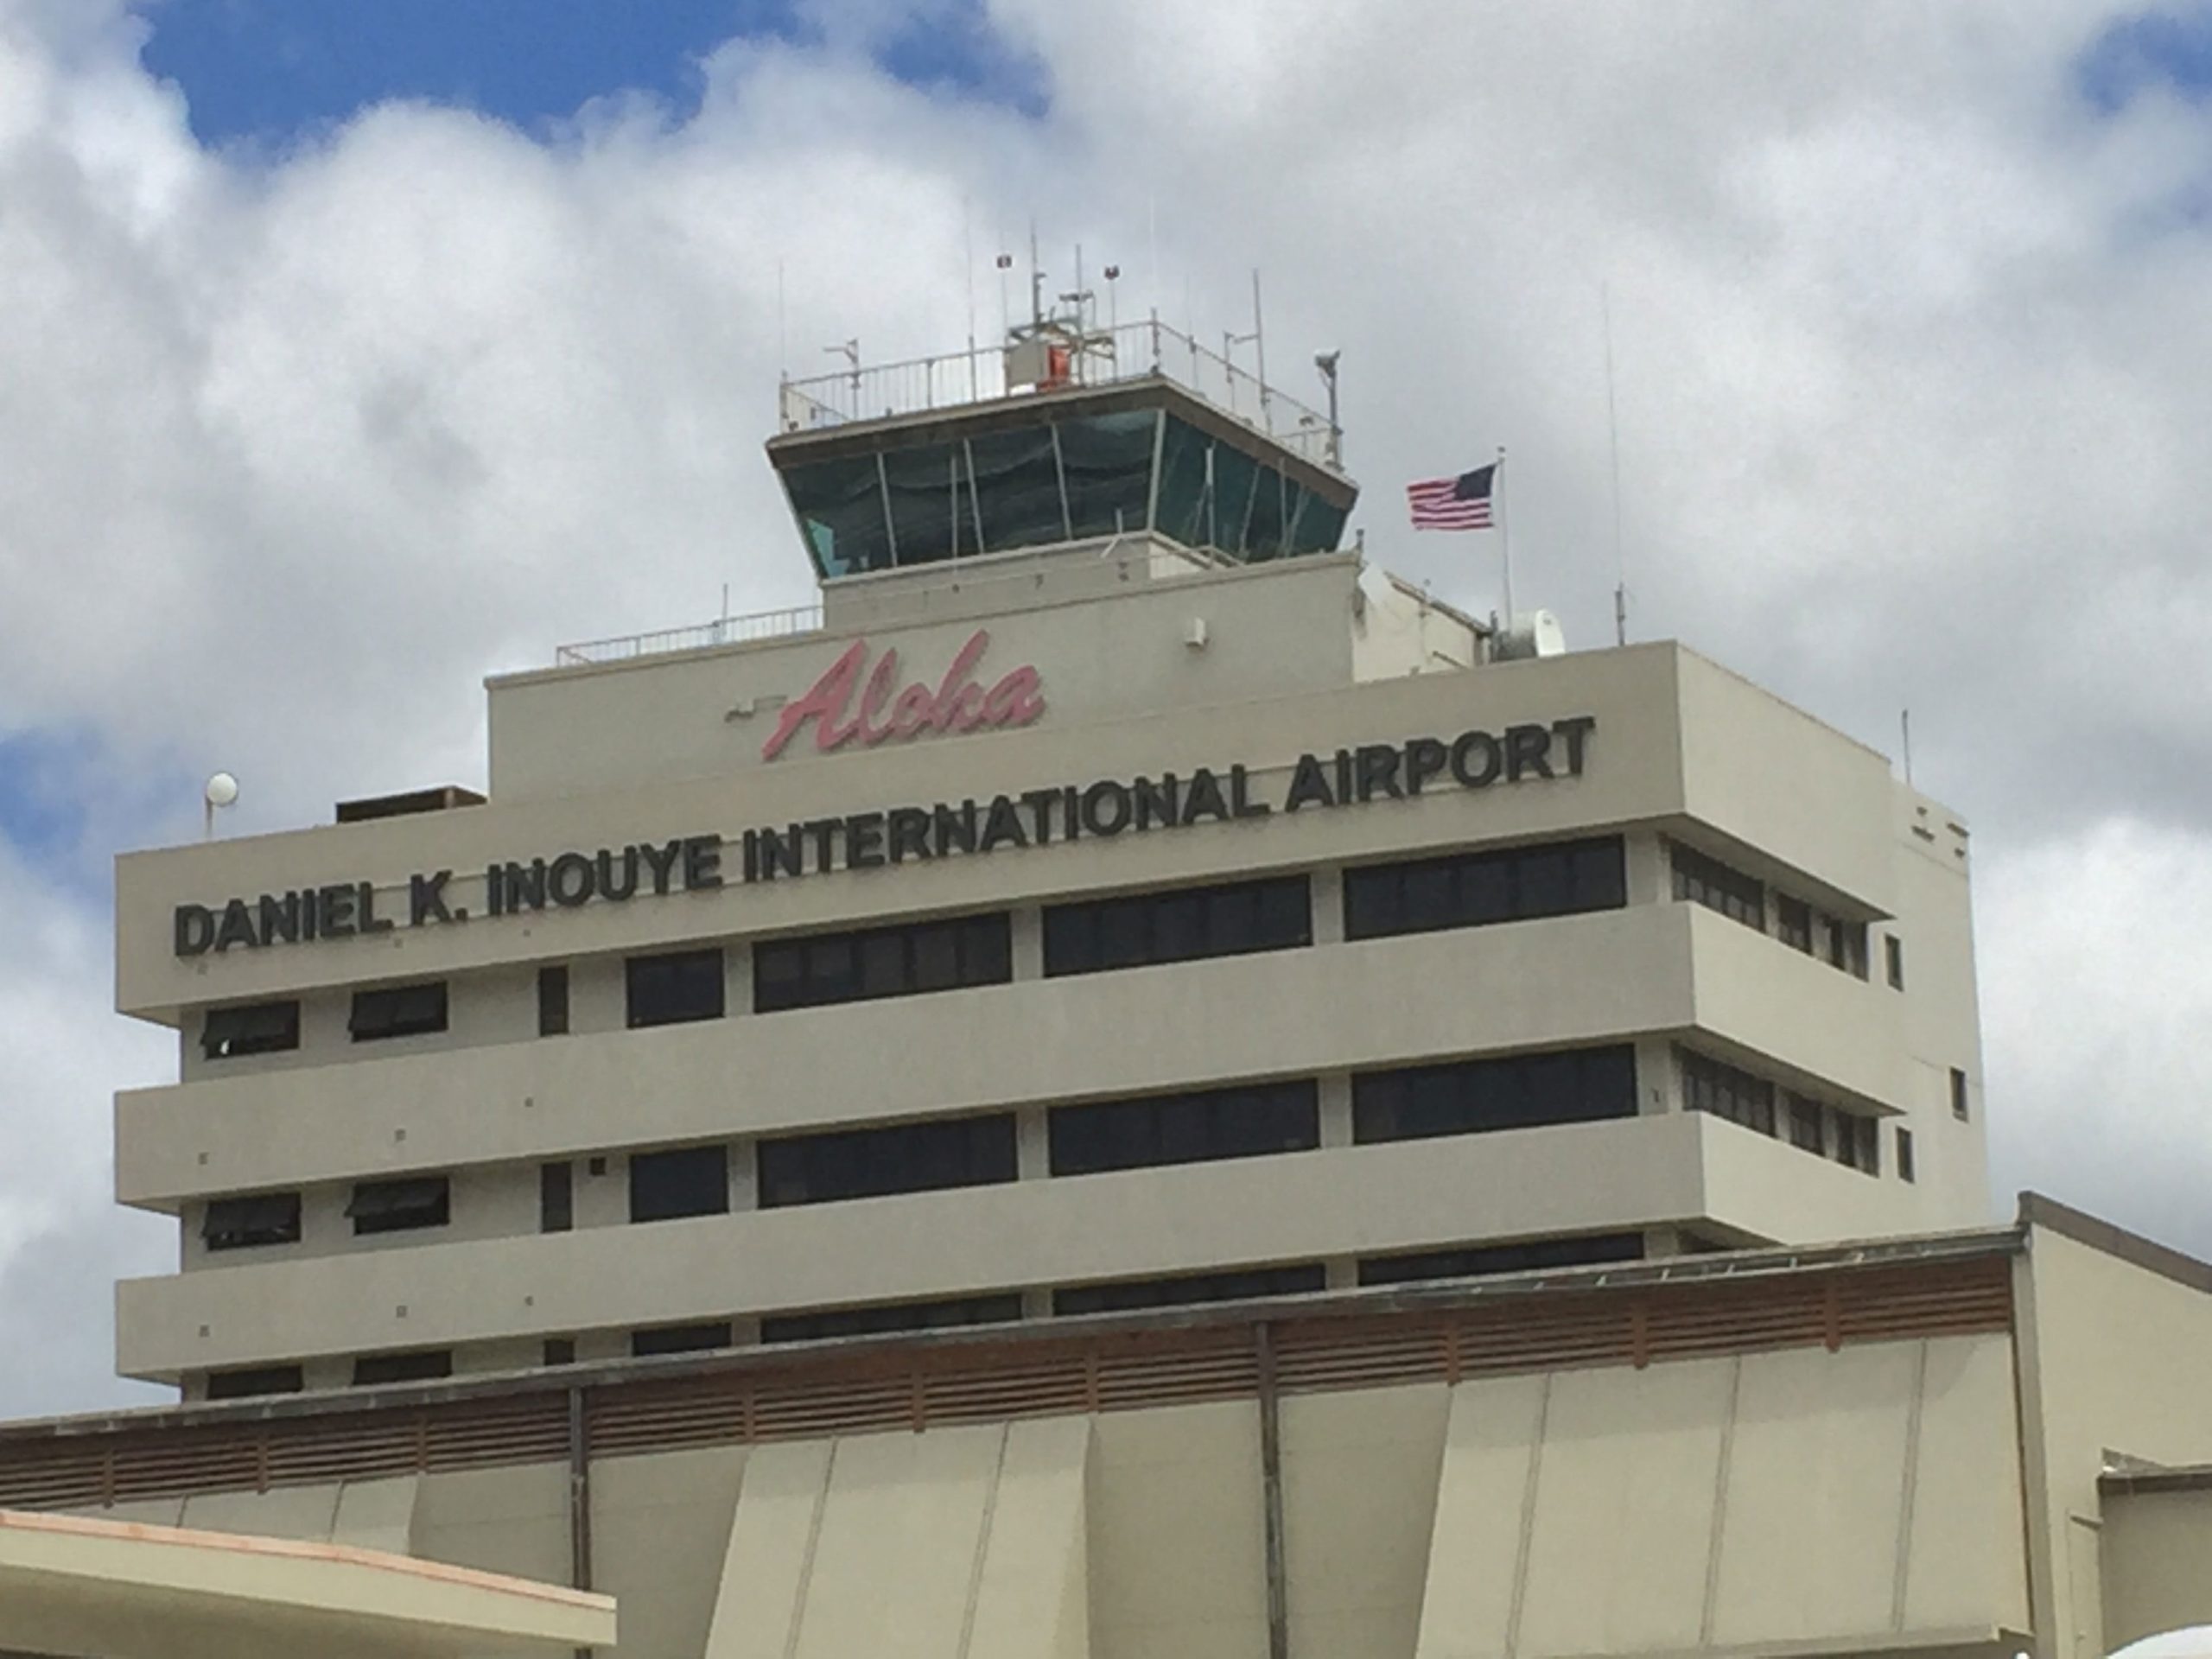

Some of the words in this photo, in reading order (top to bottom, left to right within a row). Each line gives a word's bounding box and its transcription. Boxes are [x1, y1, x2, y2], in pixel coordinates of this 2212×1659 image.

[762, 629, 1044, 761] Aloha
[175, 882, 393, 957] DANIEL
[410, 869, 468, 926] K.
[488, 834, 723, 916] INOUYE
[744, 763, 1271, 882] INTERNATIONAL
[1286, 716, 1595, 813] AIRPORT
